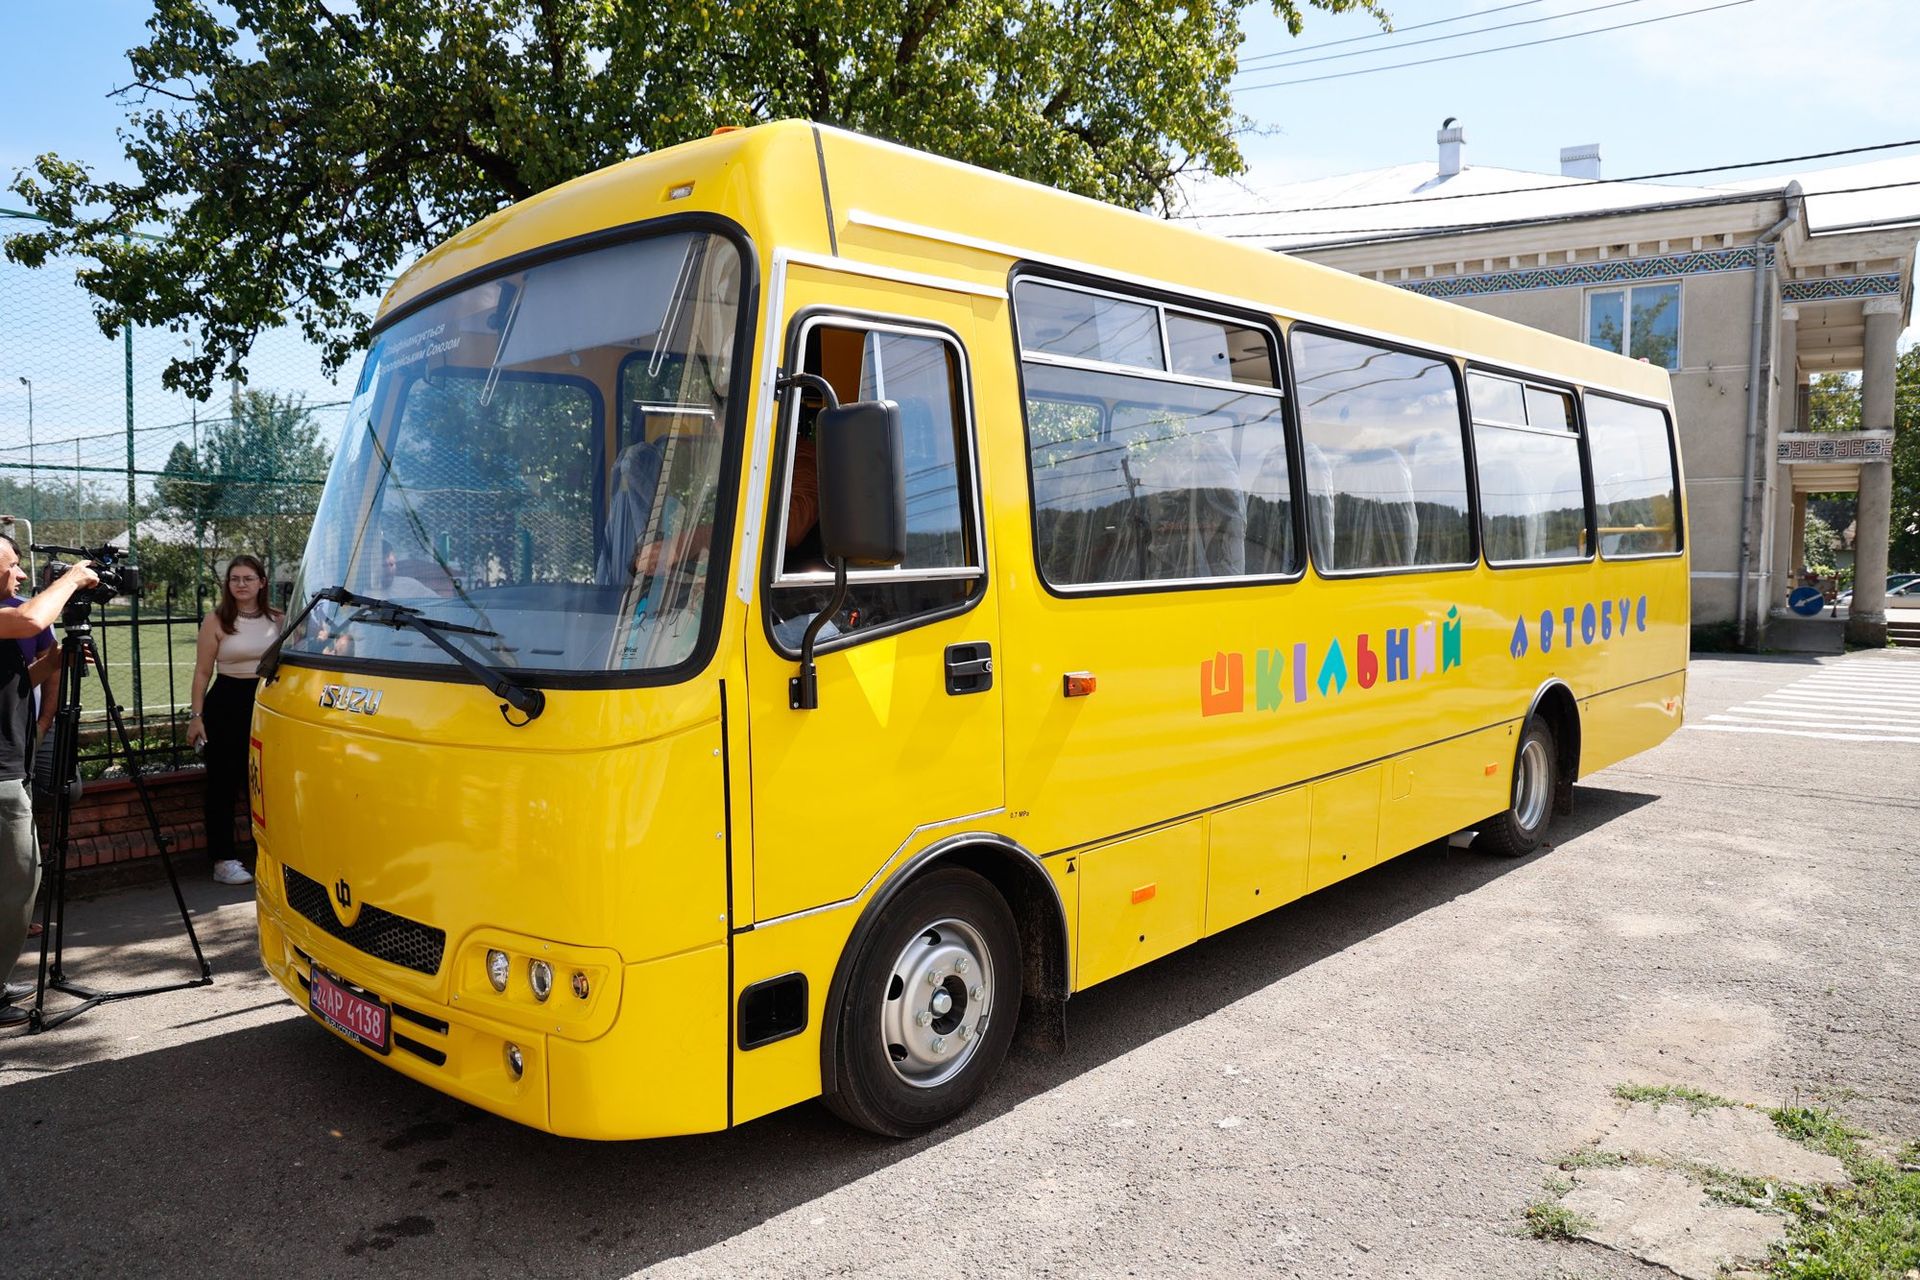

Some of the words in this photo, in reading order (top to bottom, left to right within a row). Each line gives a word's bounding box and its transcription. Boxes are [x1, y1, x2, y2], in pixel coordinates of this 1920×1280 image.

[426, 336, 461, 358] Союзом
[1200, 604, 1462, 717] ШКІЛЬНИЙ
[1510, 594, 1647, 660] АВТОБУС
[319, 683, 383, 716] ISUZU
[347, 999, 381, 1039] 4138
